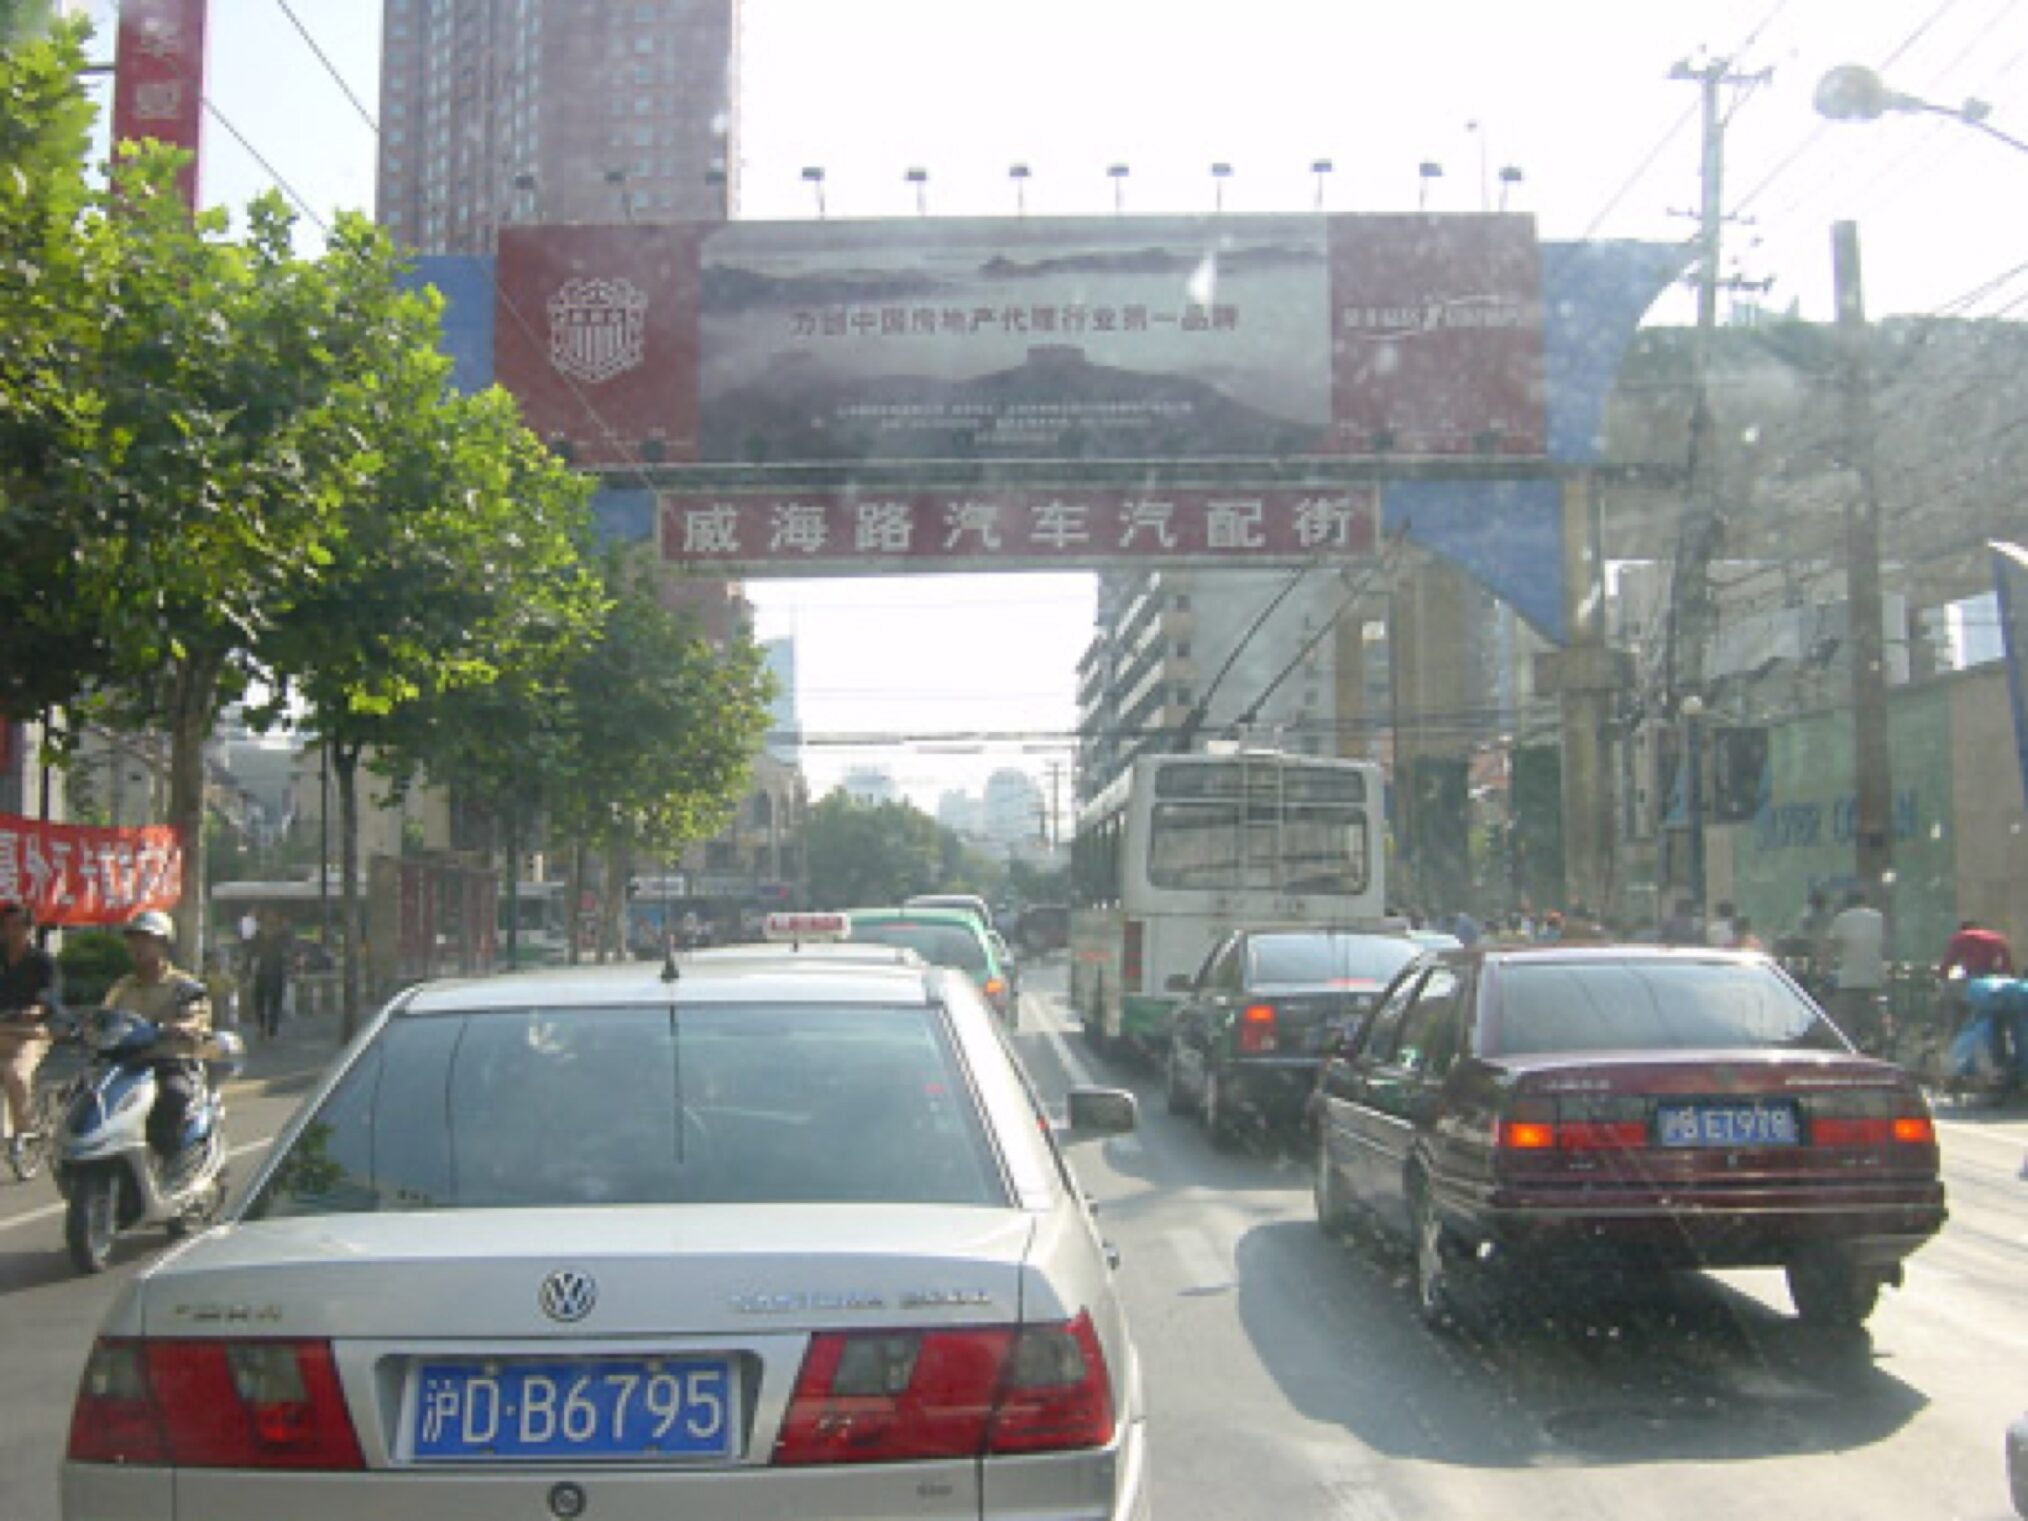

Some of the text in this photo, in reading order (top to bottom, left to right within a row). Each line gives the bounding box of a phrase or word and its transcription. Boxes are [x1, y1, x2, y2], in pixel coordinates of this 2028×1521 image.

[682, 499, 1353, 555] 威海路汽车汽配街
[422, 1370, 720, 1443] 沪D·B6795
